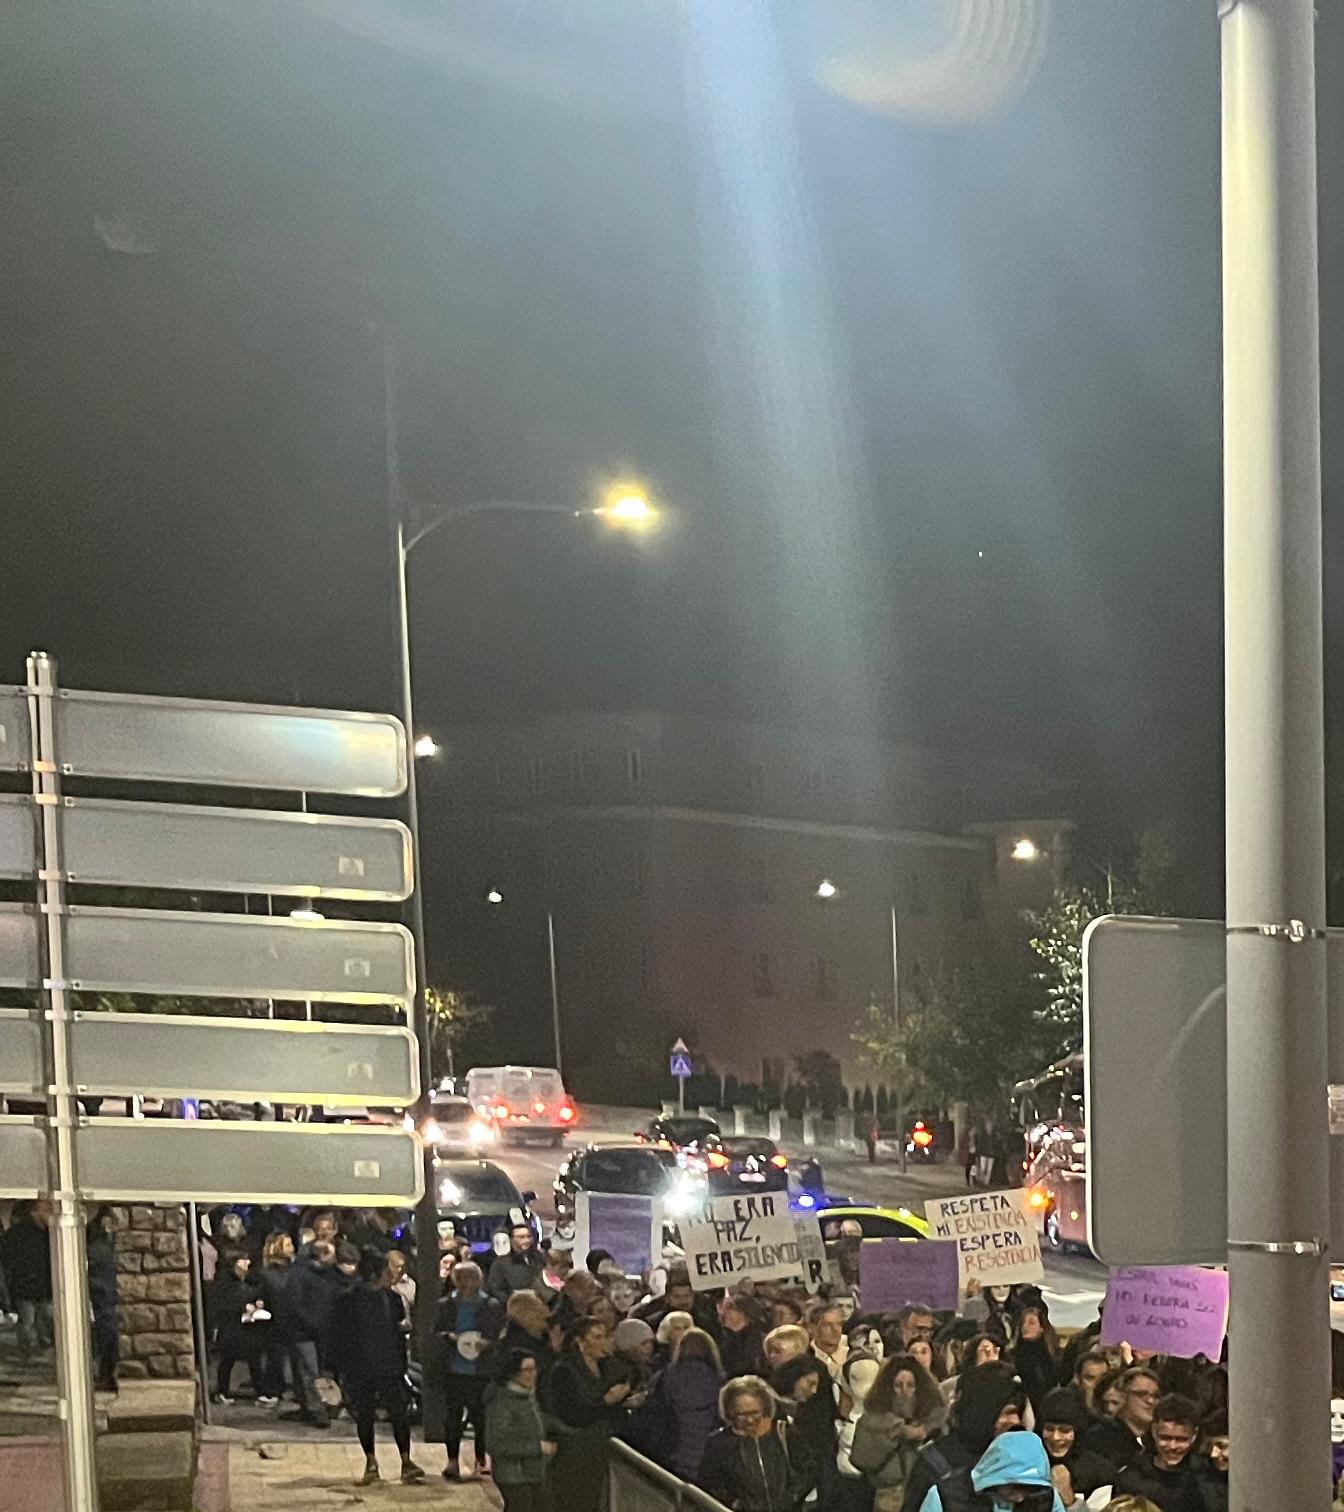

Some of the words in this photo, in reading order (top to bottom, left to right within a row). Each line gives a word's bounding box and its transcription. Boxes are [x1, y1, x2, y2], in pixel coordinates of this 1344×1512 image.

[734, 1196, 775, 1222] ERA
[940, 1195, 1010, 1217] RESPETA
[936, 1223, 951, 1237] MI
[960, 1231, 1022, 1251] ESPERA
